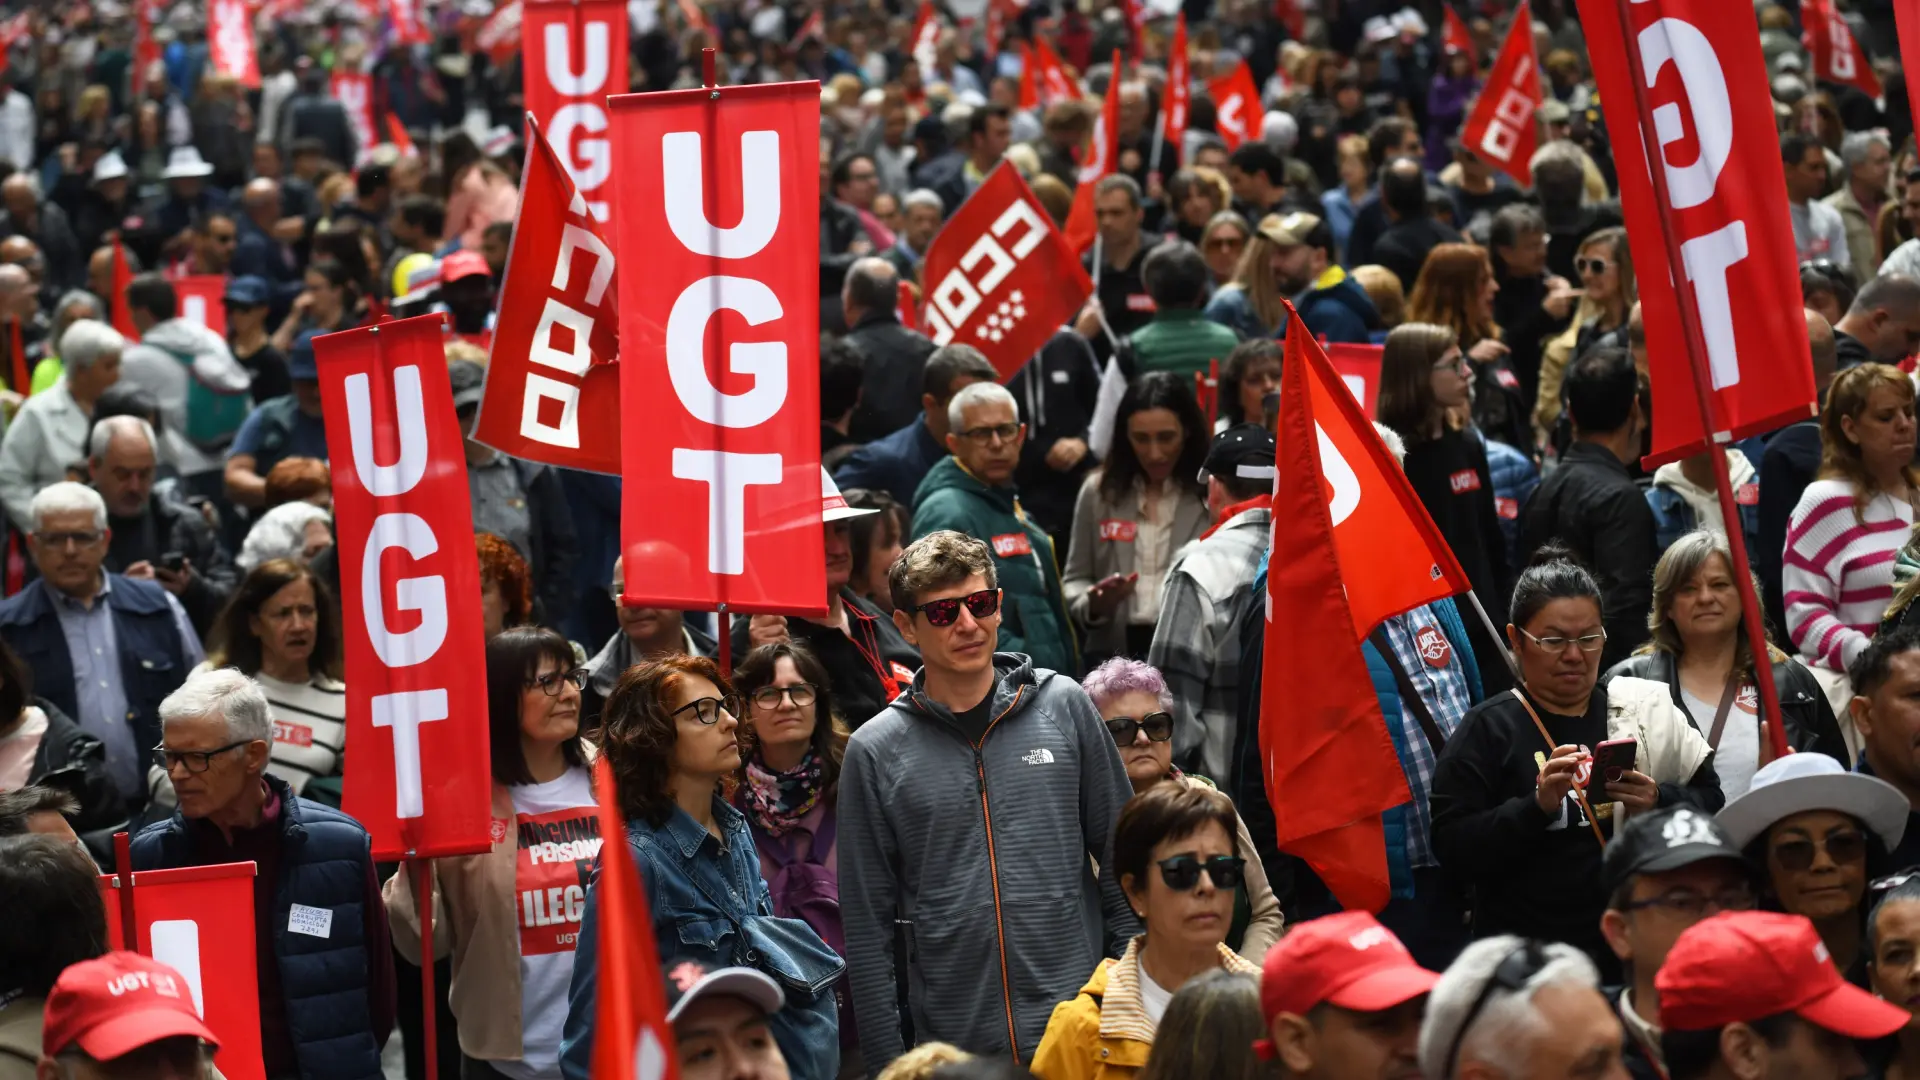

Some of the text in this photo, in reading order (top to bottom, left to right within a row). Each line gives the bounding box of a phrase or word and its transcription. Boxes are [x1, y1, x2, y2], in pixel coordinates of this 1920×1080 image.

[543, 20, 611, 223] UG
[519, 188, 616, 449] COO
[662, 130, 788, 576] UGT
[344, 364, 449, 820] UGT
[1021, 752, 1044, 762] NORTH
[522, 883, 591, 927] ILEG
[529, 838, 605, 865] PERSON
[107, 971, 150, 997] UGT
